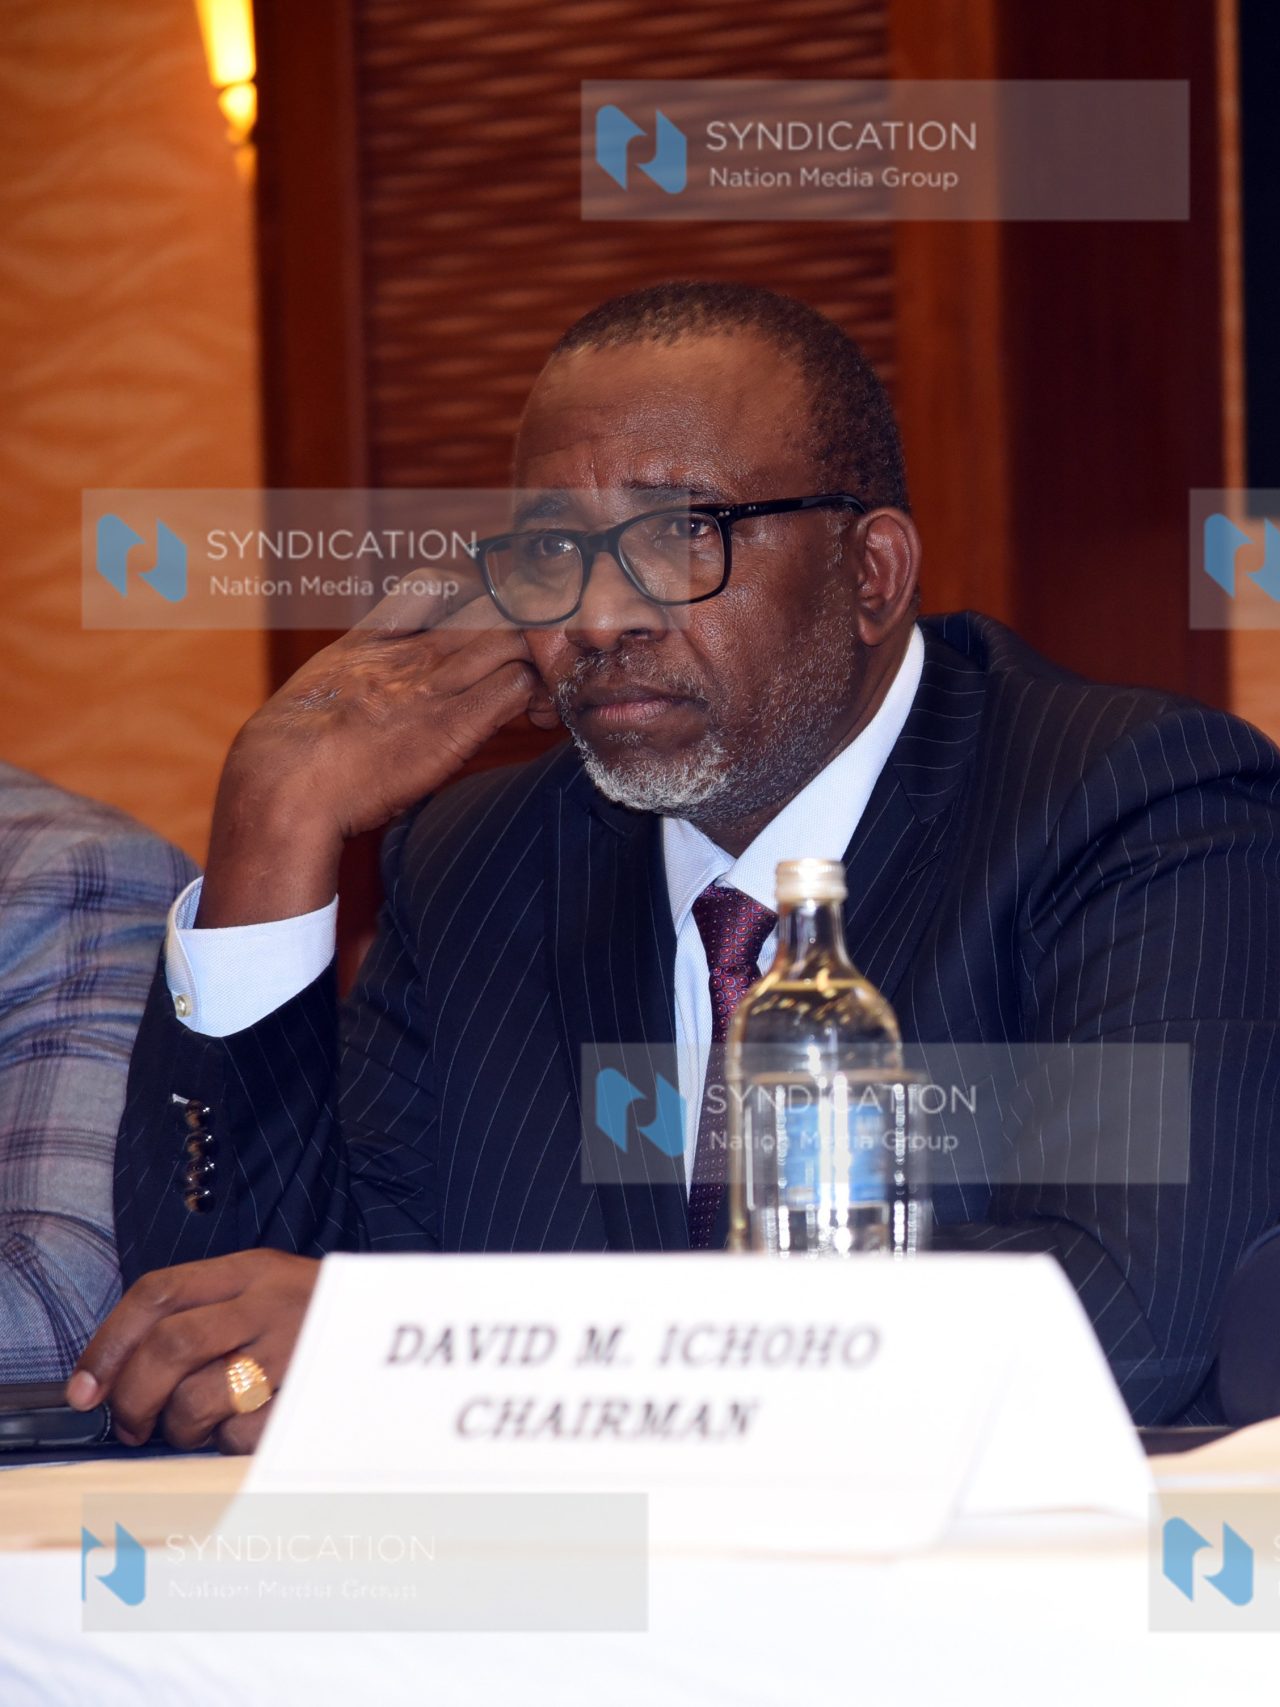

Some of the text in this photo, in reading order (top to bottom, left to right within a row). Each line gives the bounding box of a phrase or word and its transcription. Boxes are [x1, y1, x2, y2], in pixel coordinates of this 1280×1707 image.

[383, 1322, 884, 1369] DAVID M. ICHOHO
[452, 1395, 762, 1440] CHAIRMAN
